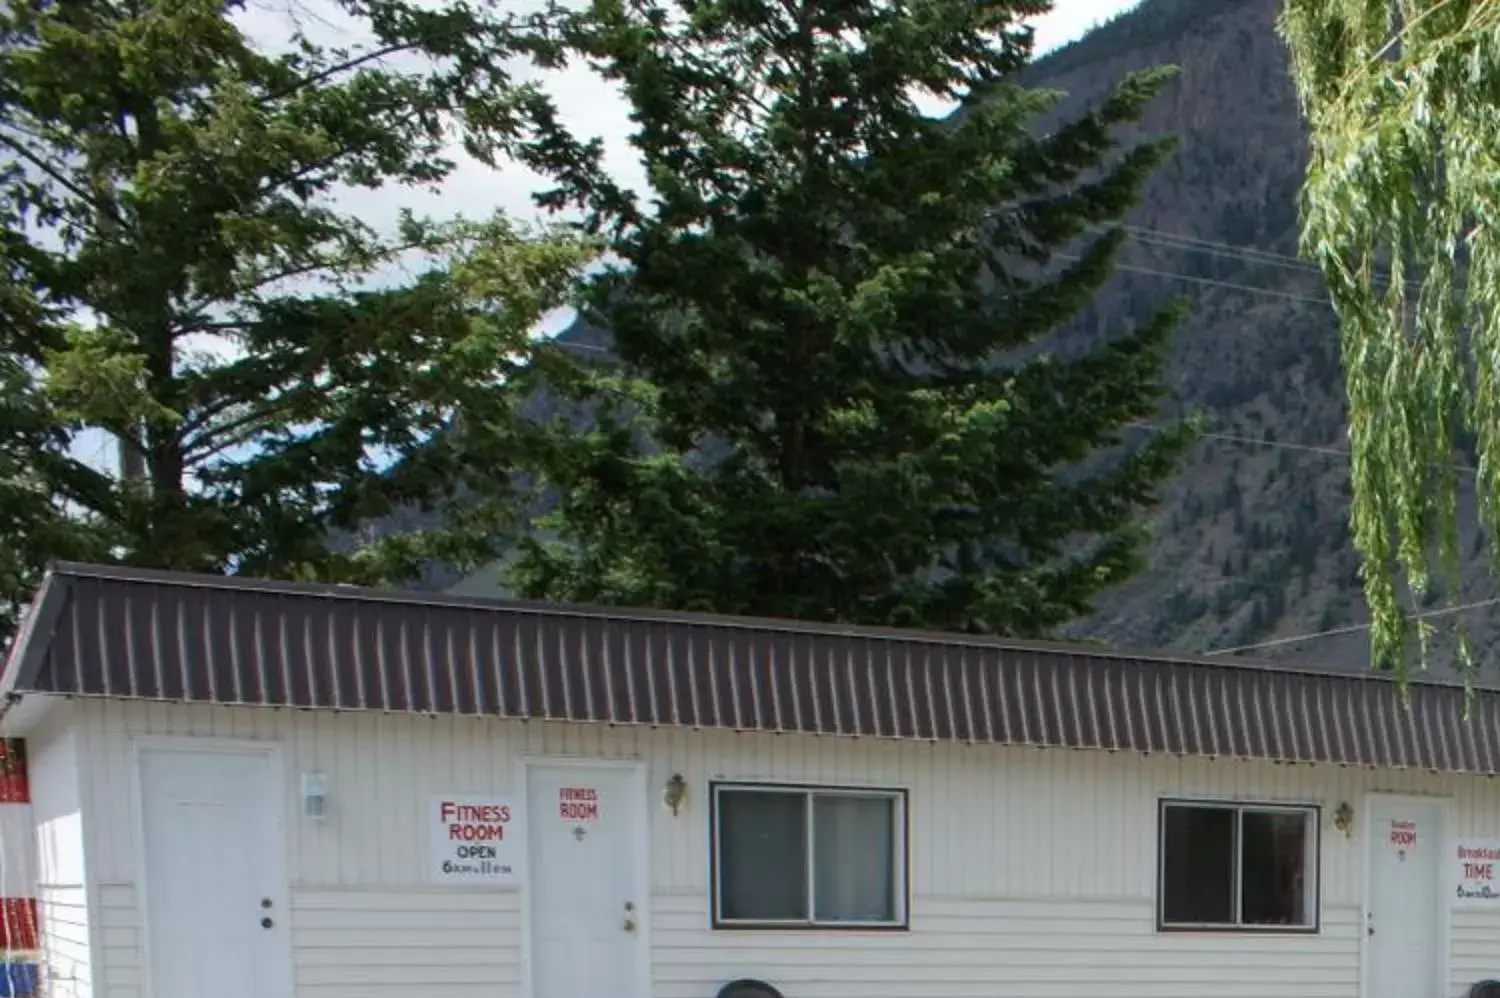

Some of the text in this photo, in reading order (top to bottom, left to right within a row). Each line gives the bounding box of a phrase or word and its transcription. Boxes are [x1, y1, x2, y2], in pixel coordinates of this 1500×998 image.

[559, 802, 598, 819] ROOM
[449, 823, 503, 841] ROOM
[457, 845, 497, 859] OPEN
[1463, 862, 1494, 881] TIME
